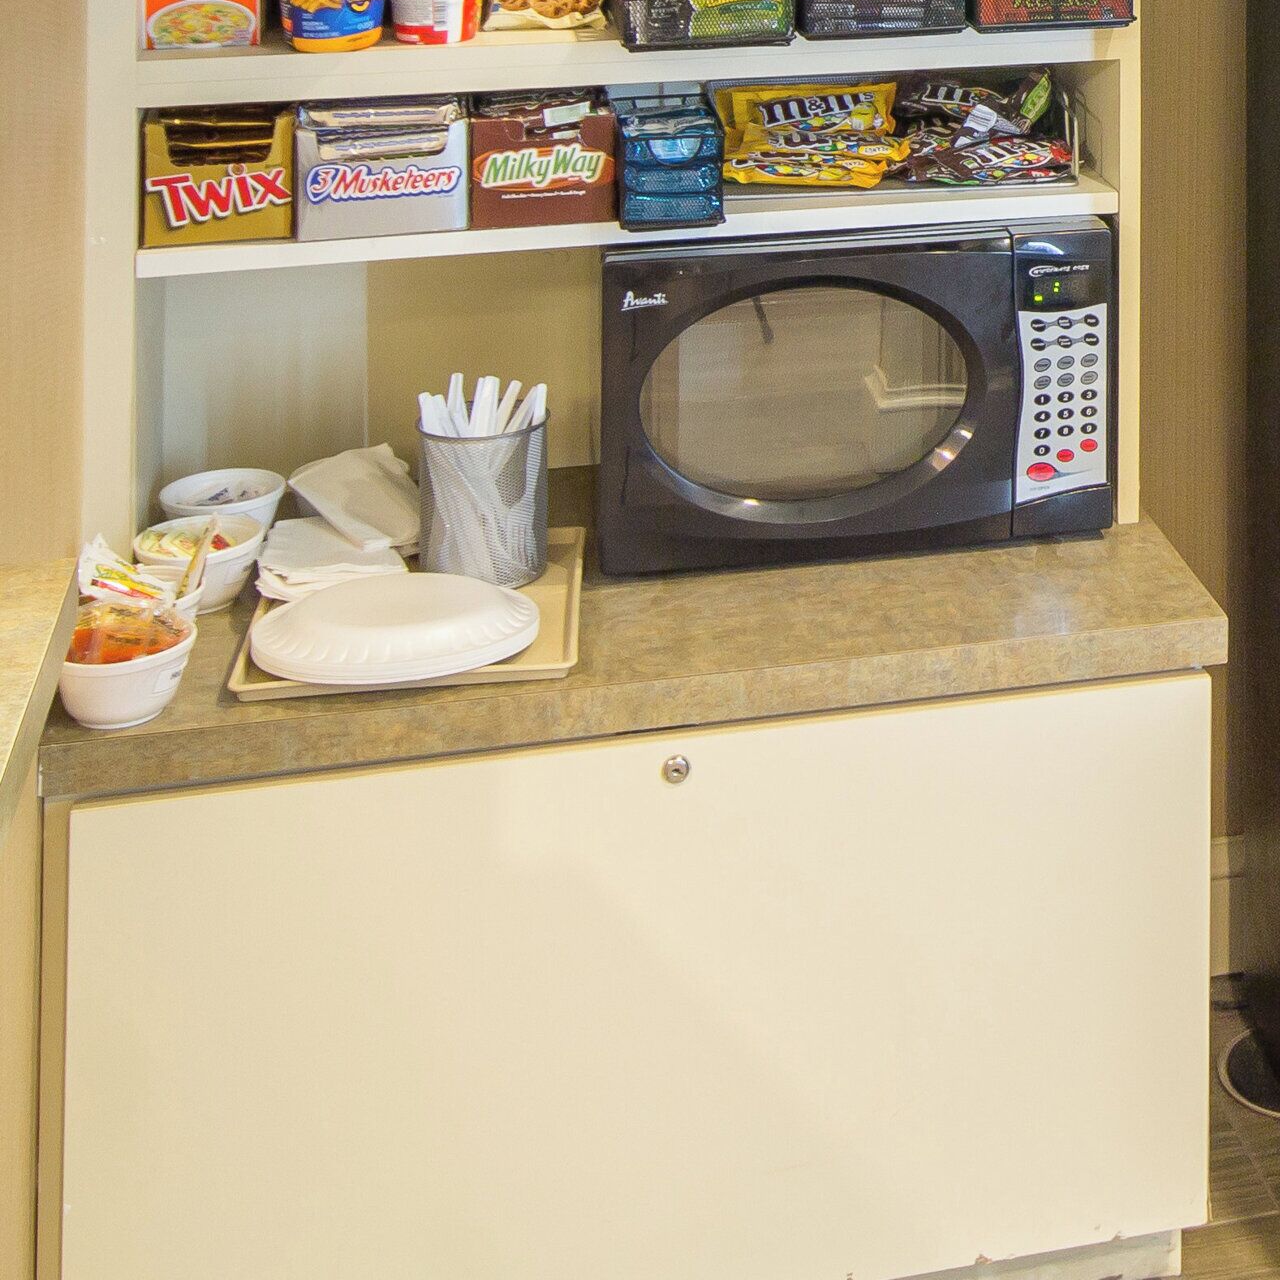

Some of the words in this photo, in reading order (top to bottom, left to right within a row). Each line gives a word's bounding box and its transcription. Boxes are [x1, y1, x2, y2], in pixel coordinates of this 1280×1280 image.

[311, 168, 332, 194] 3
[332, 164, 456, 198] Musketeers
[483, 149, 553, 188] Milky
[552, 144, 603, 182] Way
[148, 164, 293, 226] Twix
[622, 290, 668, 310] Avanti
